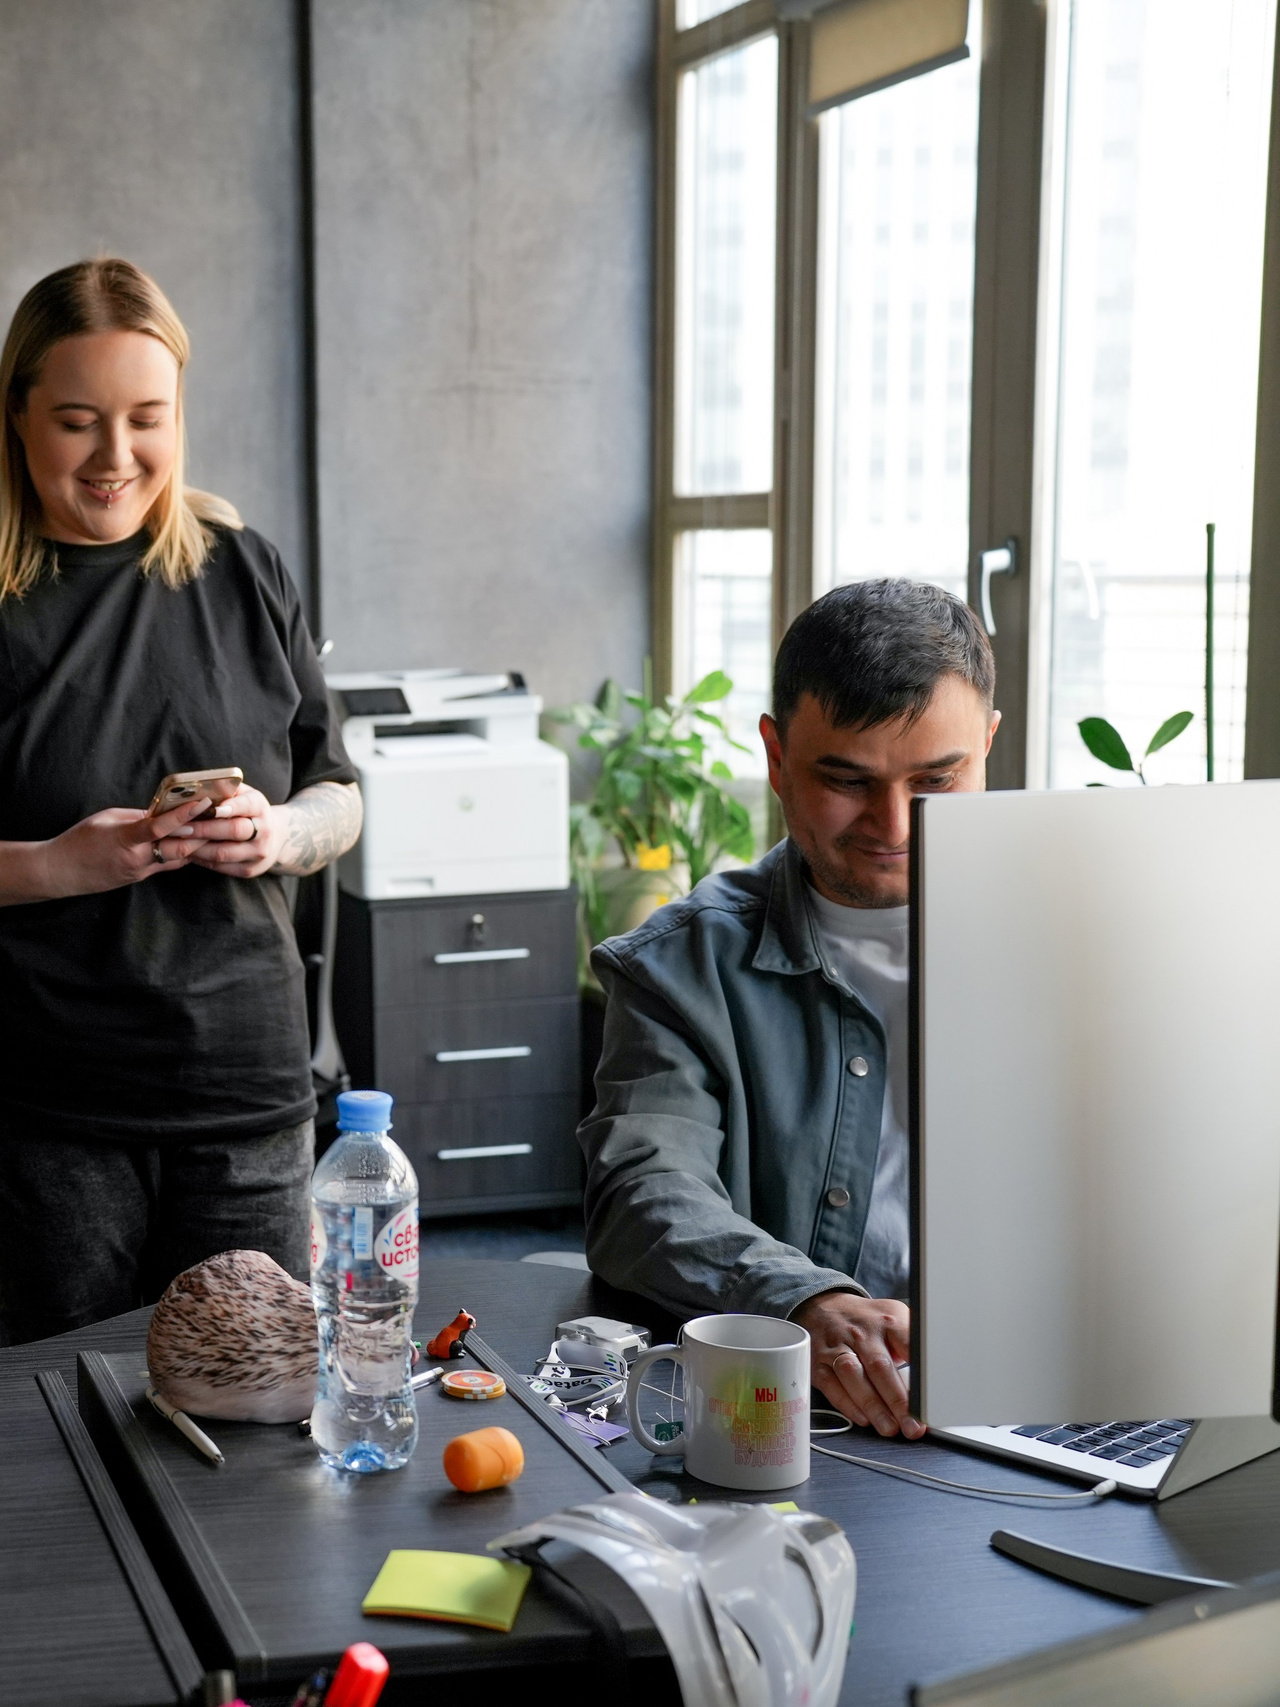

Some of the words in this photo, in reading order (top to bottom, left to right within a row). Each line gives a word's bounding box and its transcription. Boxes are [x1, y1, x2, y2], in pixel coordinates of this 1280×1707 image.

[755, 1387, 777, 1403] МЫ
[732, 1416, 795, 1435] СМЕЛОСТЬ
[730, 1432, 797, 1450] ЧЕСТНОСТЬ
[734, 1448, 794, 1468] БУДУЩЕЕ
